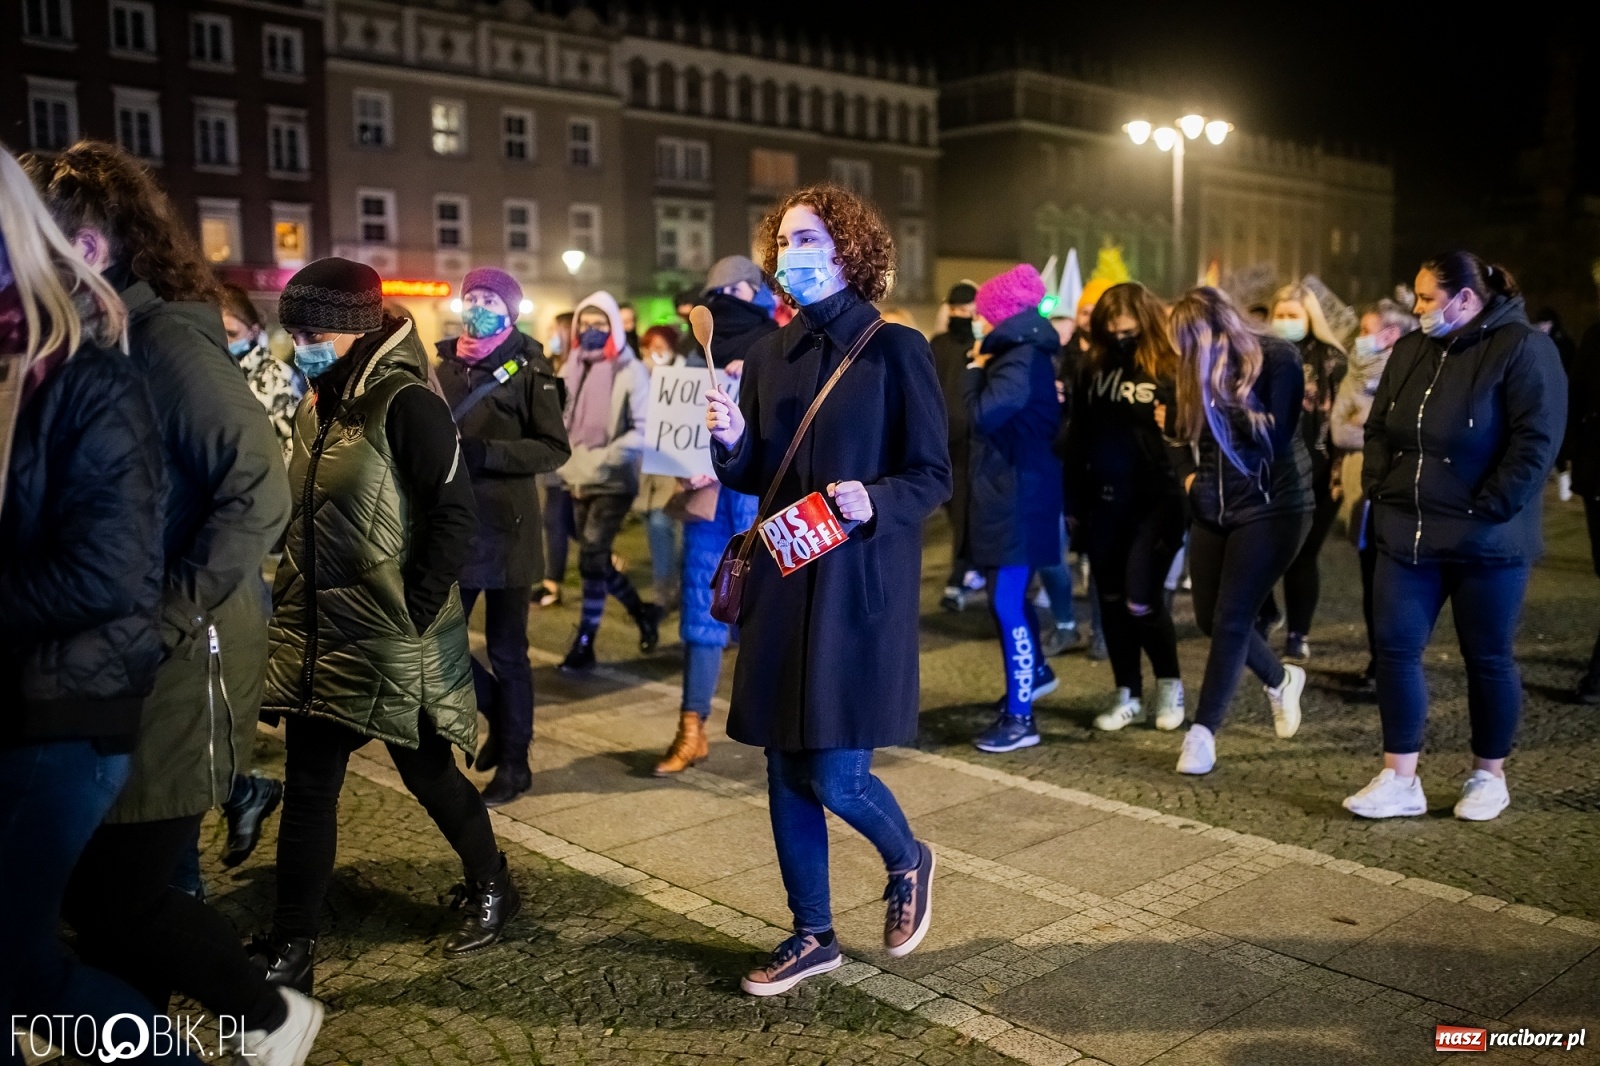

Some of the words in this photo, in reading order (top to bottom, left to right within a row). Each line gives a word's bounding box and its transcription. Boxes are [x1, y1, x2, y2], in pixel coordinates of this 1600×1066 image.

[658, 376, 739, 406] WOL
[656, 421, 709, 452] POL
[763, 506, 808, 551] PIS
[792, 519, 843, 560] OFF!
[1011, 626, 1034, 703] adidas
